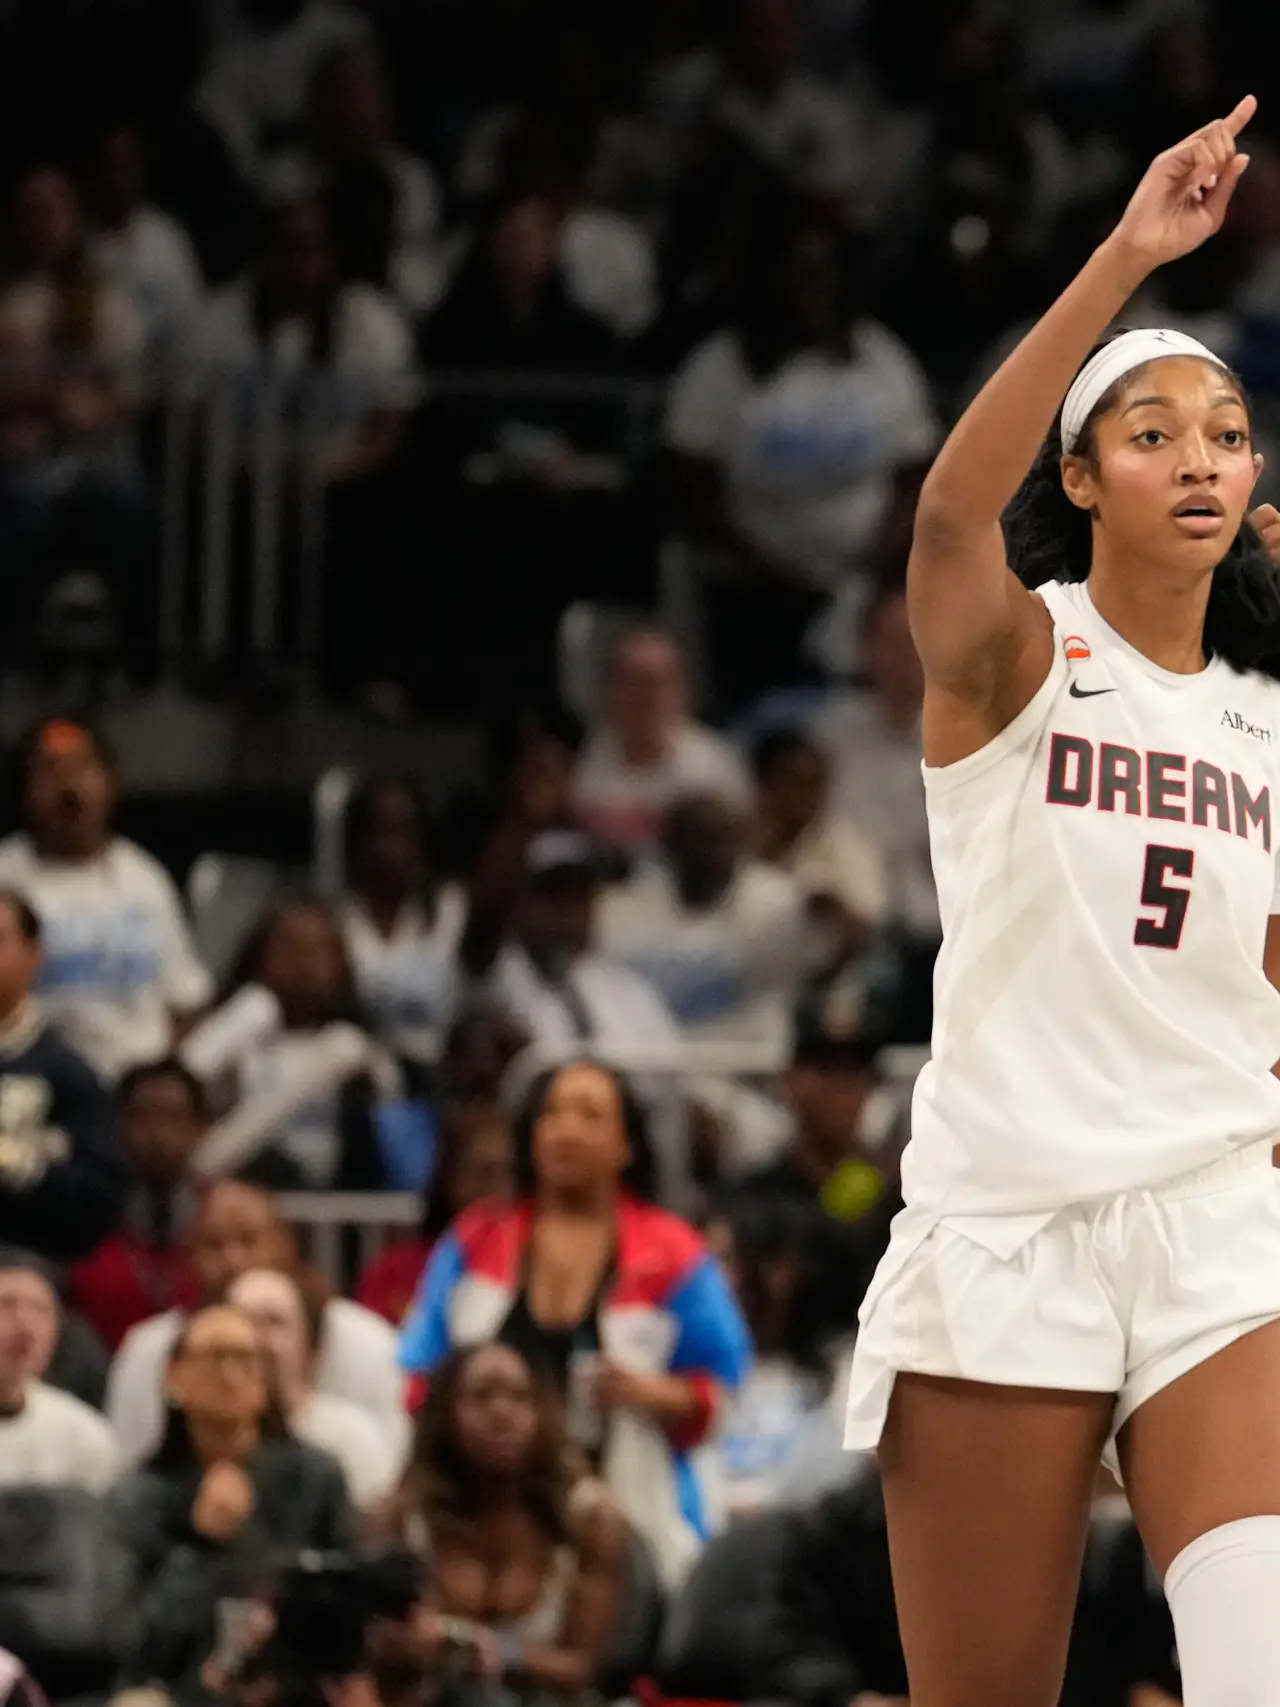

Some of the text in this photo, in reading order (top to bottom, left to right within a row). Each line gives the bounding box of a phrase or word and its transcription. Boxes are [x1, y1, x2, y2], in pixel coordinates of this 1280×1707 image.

[1220, 708, 1272, 746] Albert
[1045, 732, 1271, 855] DREAM
[1133, 843, 1195, 950] 5
